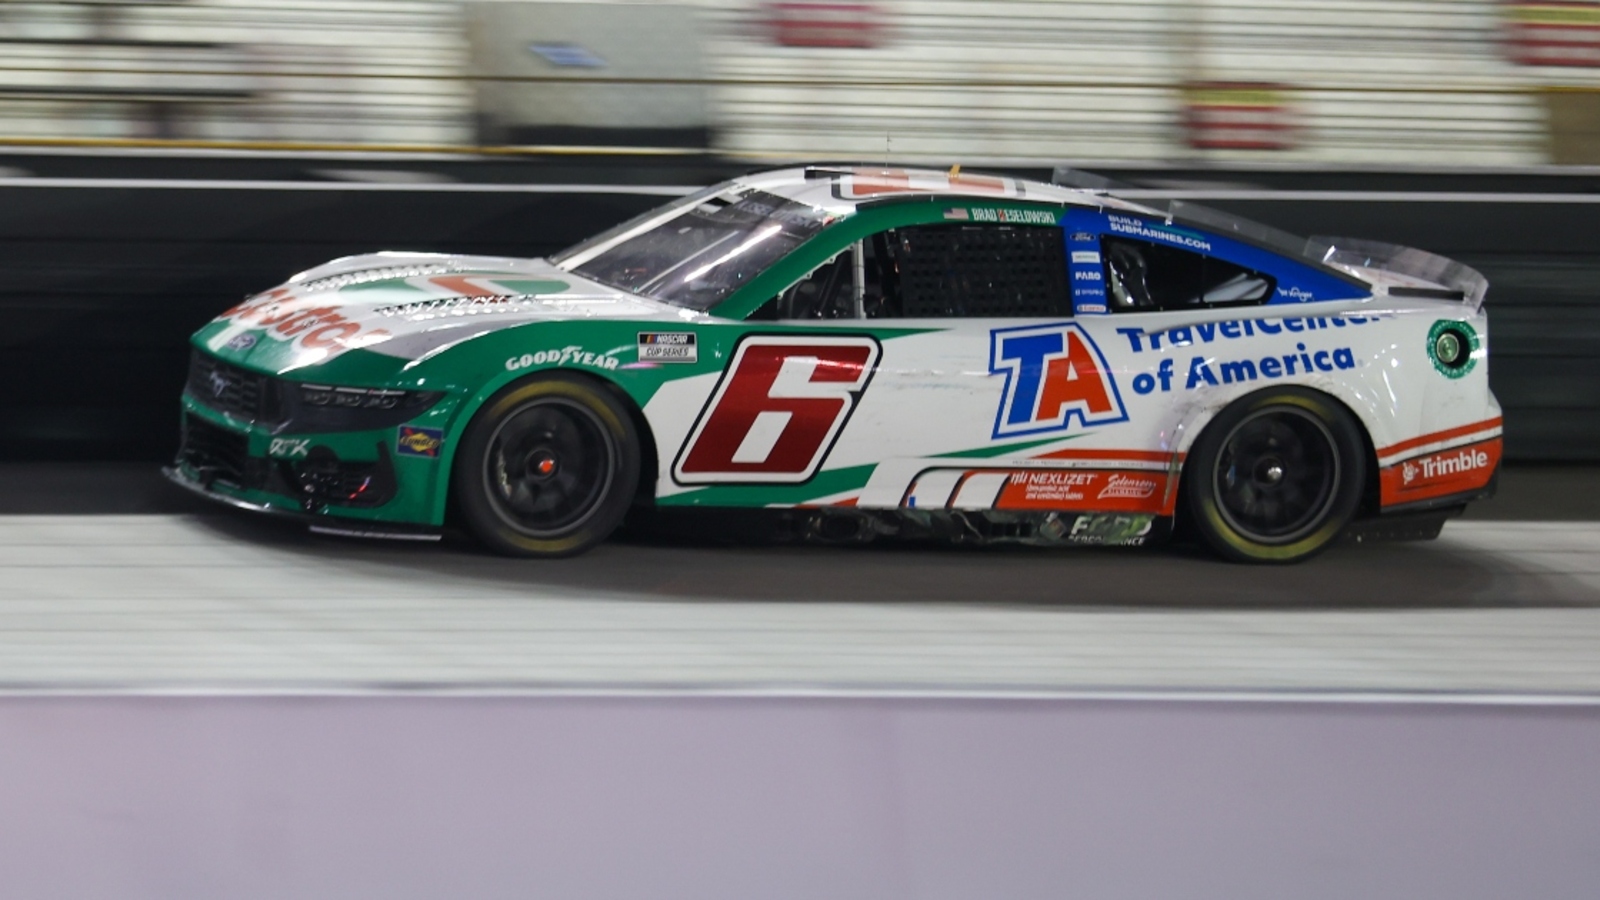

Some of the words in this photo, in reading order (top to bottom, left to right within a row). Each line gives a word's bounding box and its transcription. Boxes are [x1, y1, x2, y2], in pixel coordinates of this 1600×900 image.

[971, 208, 997, 222] BRAD
[1107, 214, 1143, 227] BUILD
[1109, 222, 1211, 252] SUBMARINES.COM
[656, 334, 688, 344] NASCAR
[645, 346, 662, 356] CUP
[662, 346, 689, 357] SERIES
[996, 327, 1120, 431] TA
[1132, 359, 1174, 395] of
[1185, 343, 1355, 389] America
[676, 339, 876, 479] 6
[1419, 449, 1488, 478] Trimble
[1028, 472, 1095, 485] NEXLIZET
